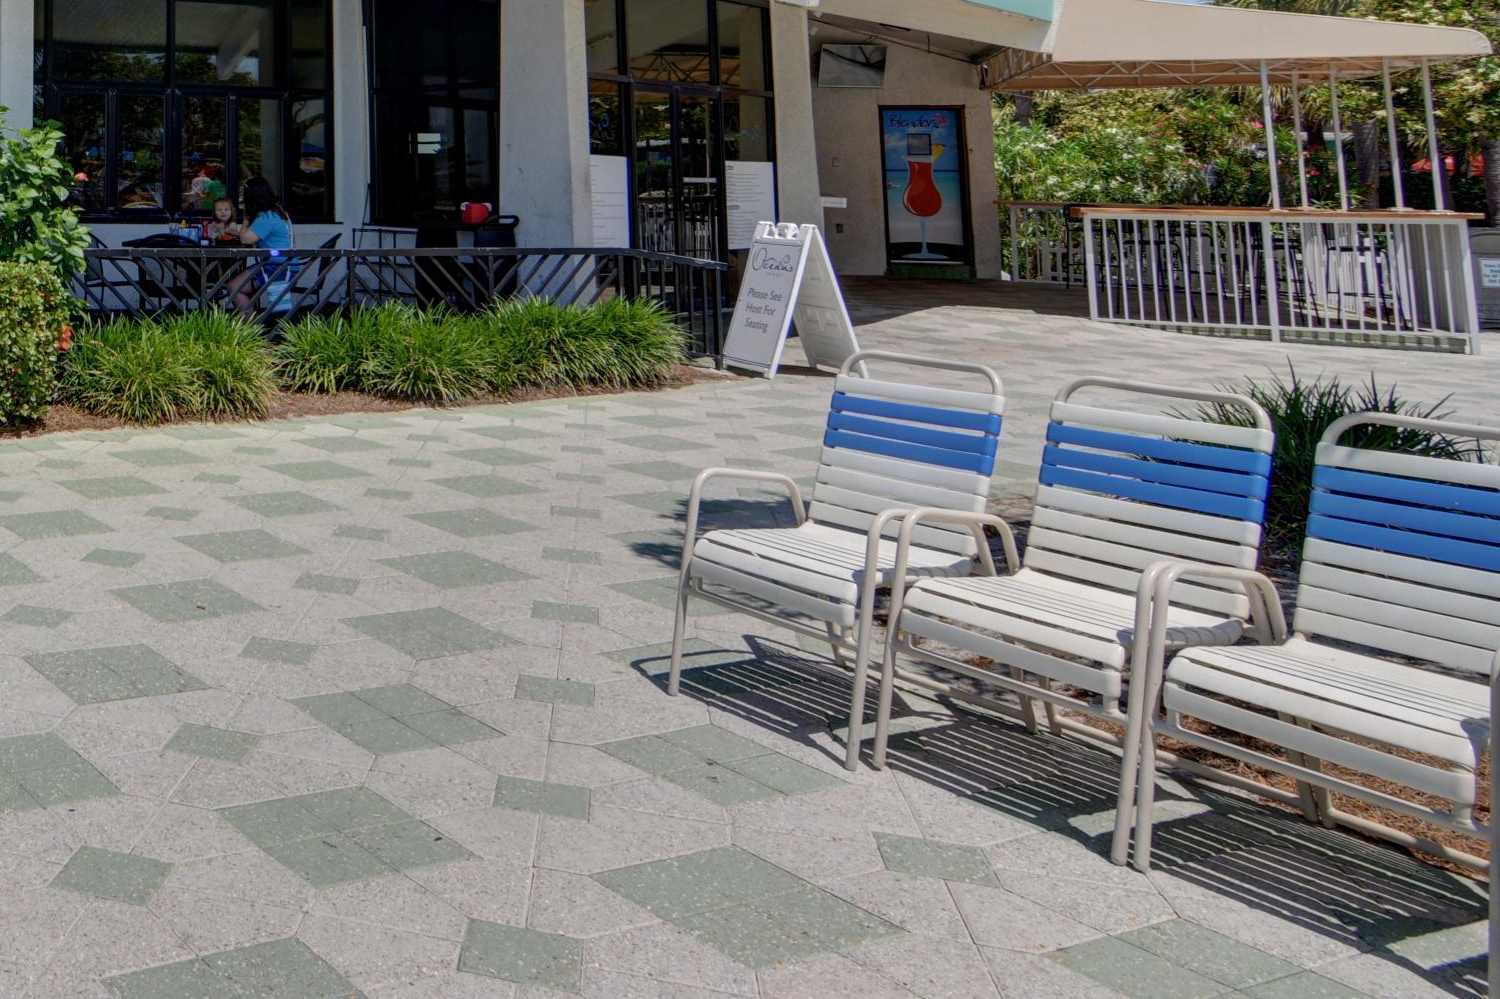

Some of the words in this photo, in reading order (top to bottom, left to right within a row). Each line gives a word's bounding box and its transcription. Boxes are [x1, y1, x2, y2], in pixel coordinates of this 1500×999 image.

[752, 247, 794, 273] Oceans
[747, 287, 769, 300] Please
[769, 290, 783, 301] See
[746, 303, 762, 315] Host
[763, 304, 776, 316] For
[744, 317, 769, 334] Seating
